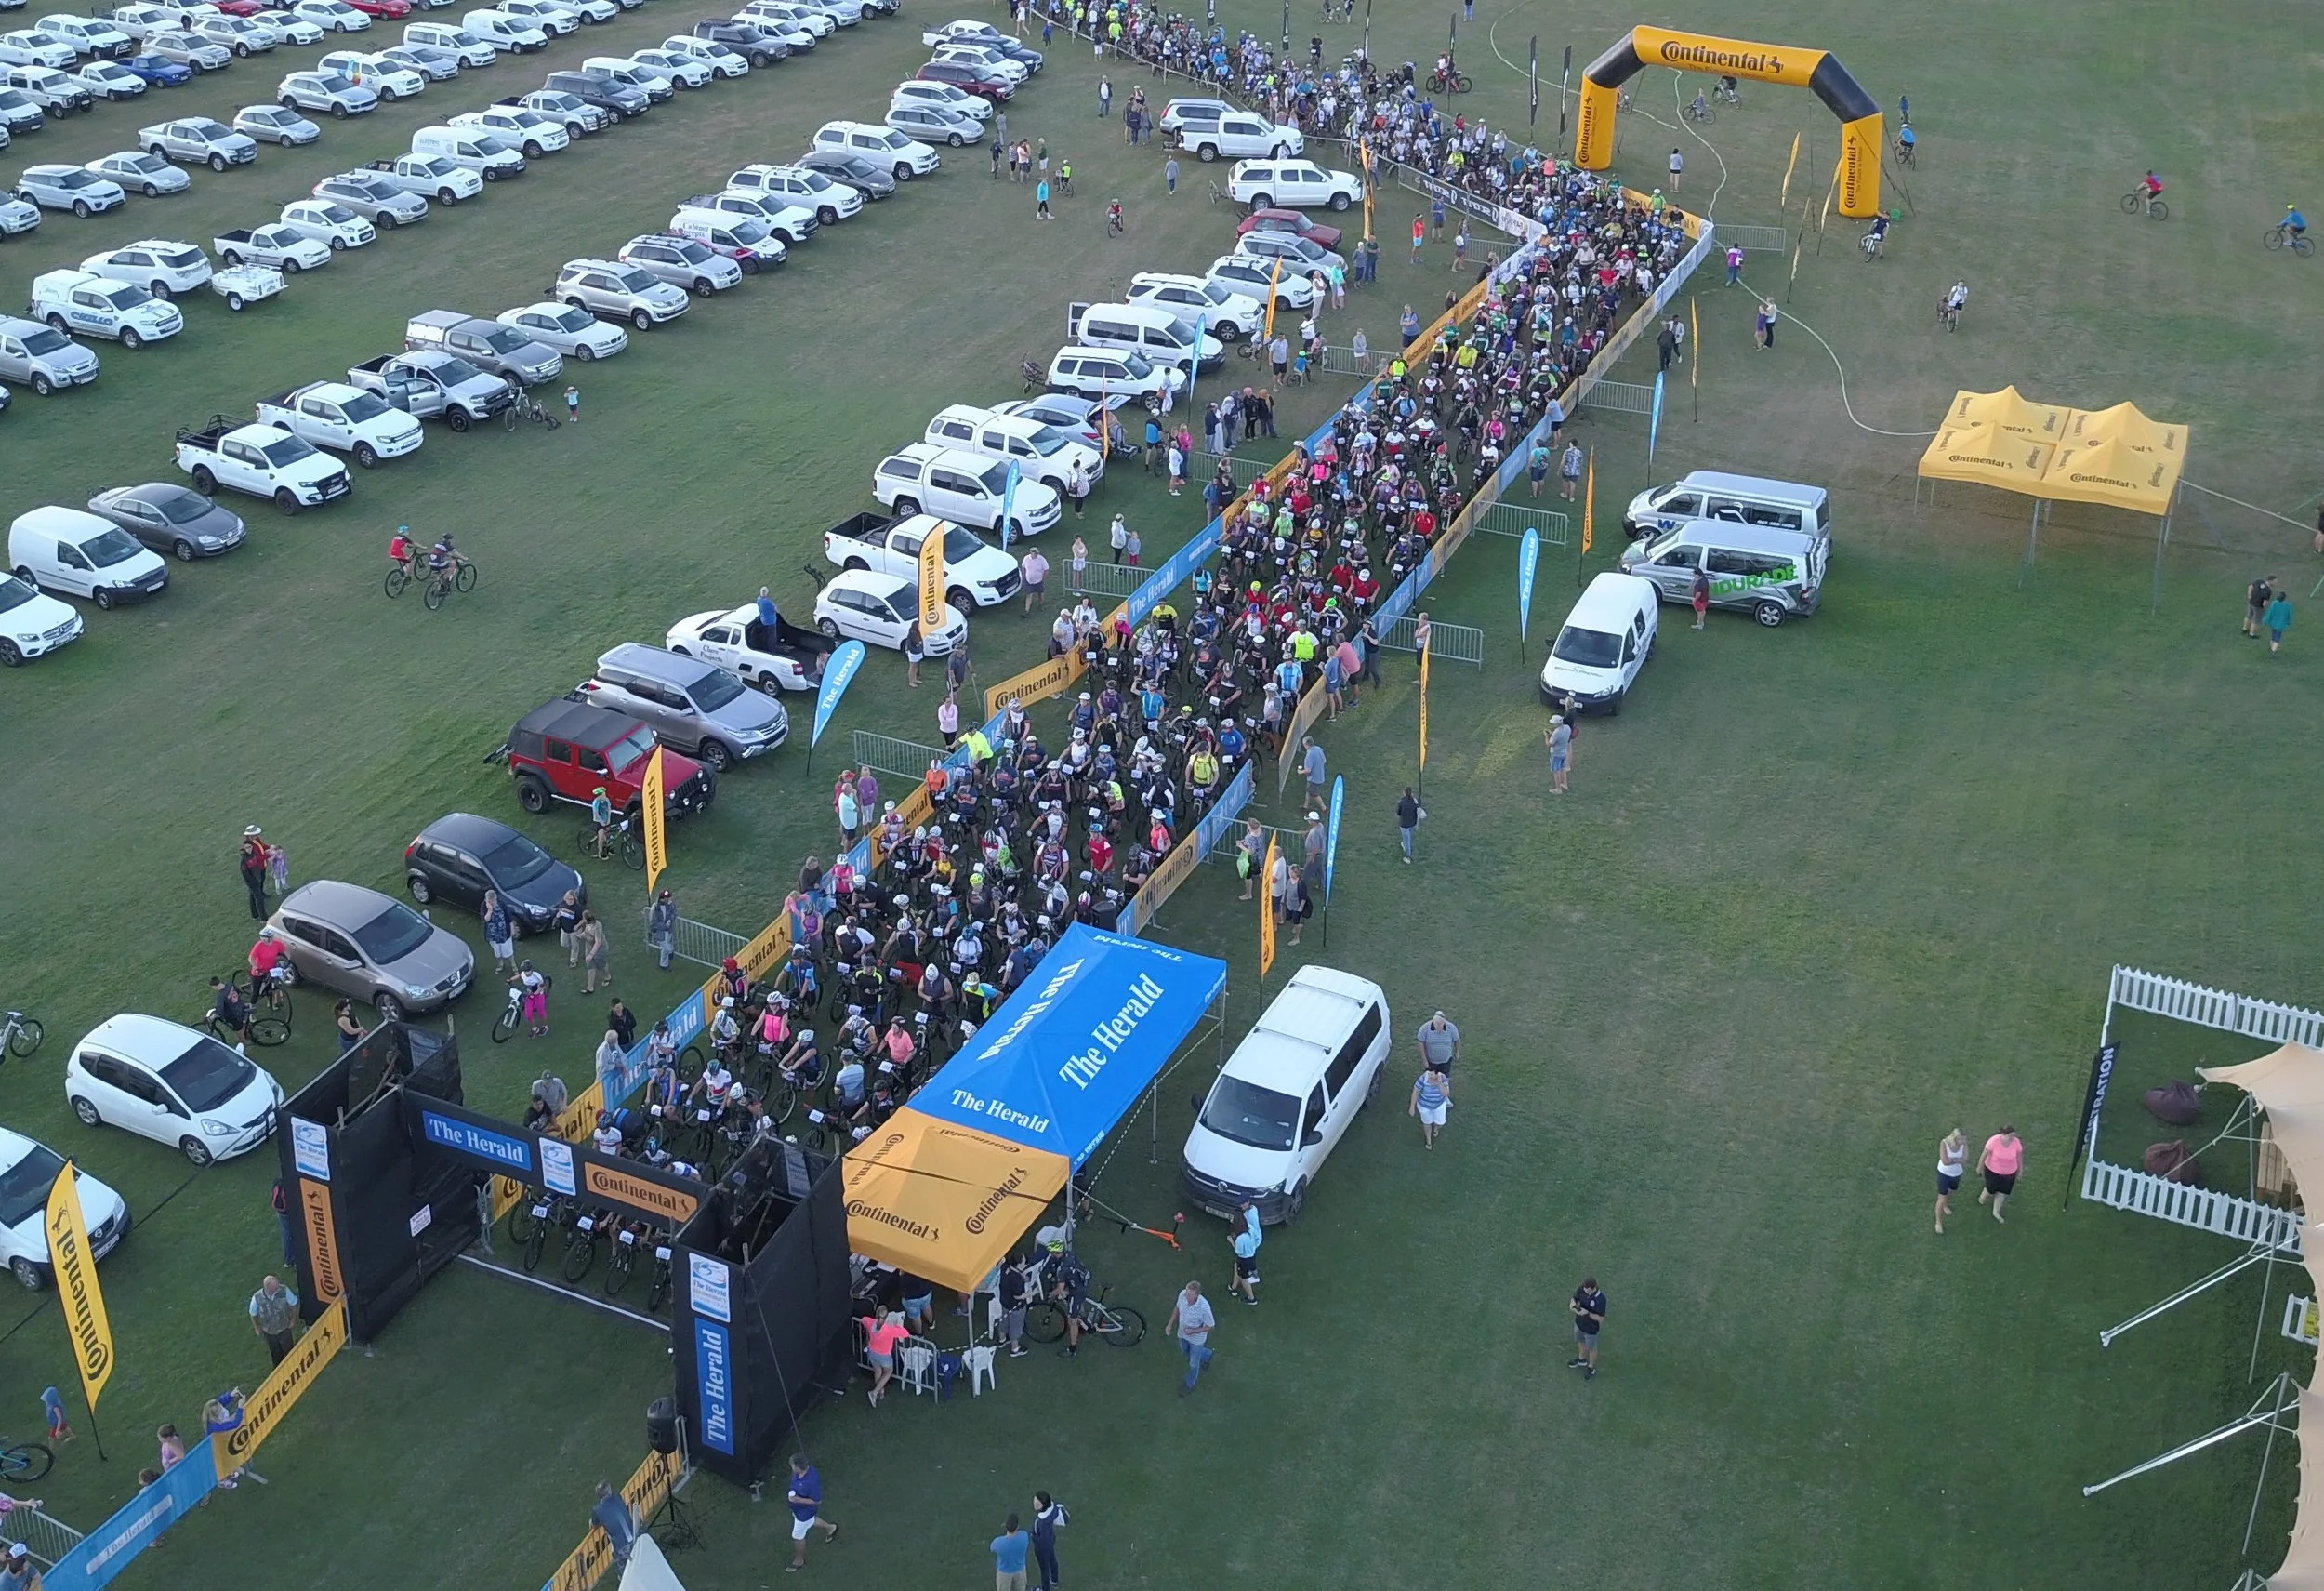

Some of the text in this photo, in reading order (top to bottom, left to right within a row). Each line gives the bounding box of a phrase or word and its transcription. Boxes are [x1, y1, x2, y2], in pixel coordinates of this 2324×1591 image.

[1661, 41, 1766, 72] Continental
[1578, 105, 1592, 164] Continental
[1844, 147, 1857, 209] Continental
[1948, 454, 2005, 468] Continental
[2070, 472, 2130, 488] Continental
[926, 552, 939, 626] Continental
[1131, 567, 1174, 617] The Herald
[1521, 537, 1537, 601] The Herald
[821, 648, 860, 710] The Herald
[995, 668, 1062, 710] Continental
[648, 788, 658, 872] Continental
[1039, 958, 1086, 999] The
[1058, 1048, 1107, 1092] The
[1091, 972, 1165, 1054] Herald
[951, 1089, 1050, 1134] The Herald
[429, 1118, 524, 1163] The Herald
[592, 1171, 677, 1211] Continental
[965, 1173, 1021, 1235] Continental
[846, 1199, 930, 1239] Continental
[310, 1204, 340, 1297] Continental
[56, 1231, 109, 1382] Continental
[693, 1279, 727, 1298] The Herald
[702, 1329, 724, 1401] Herald
[227, 1339, 322, 1456] Continental
[708, 1402, 727, 1443] The
[104, 1509, 157, 1558] The Herald
